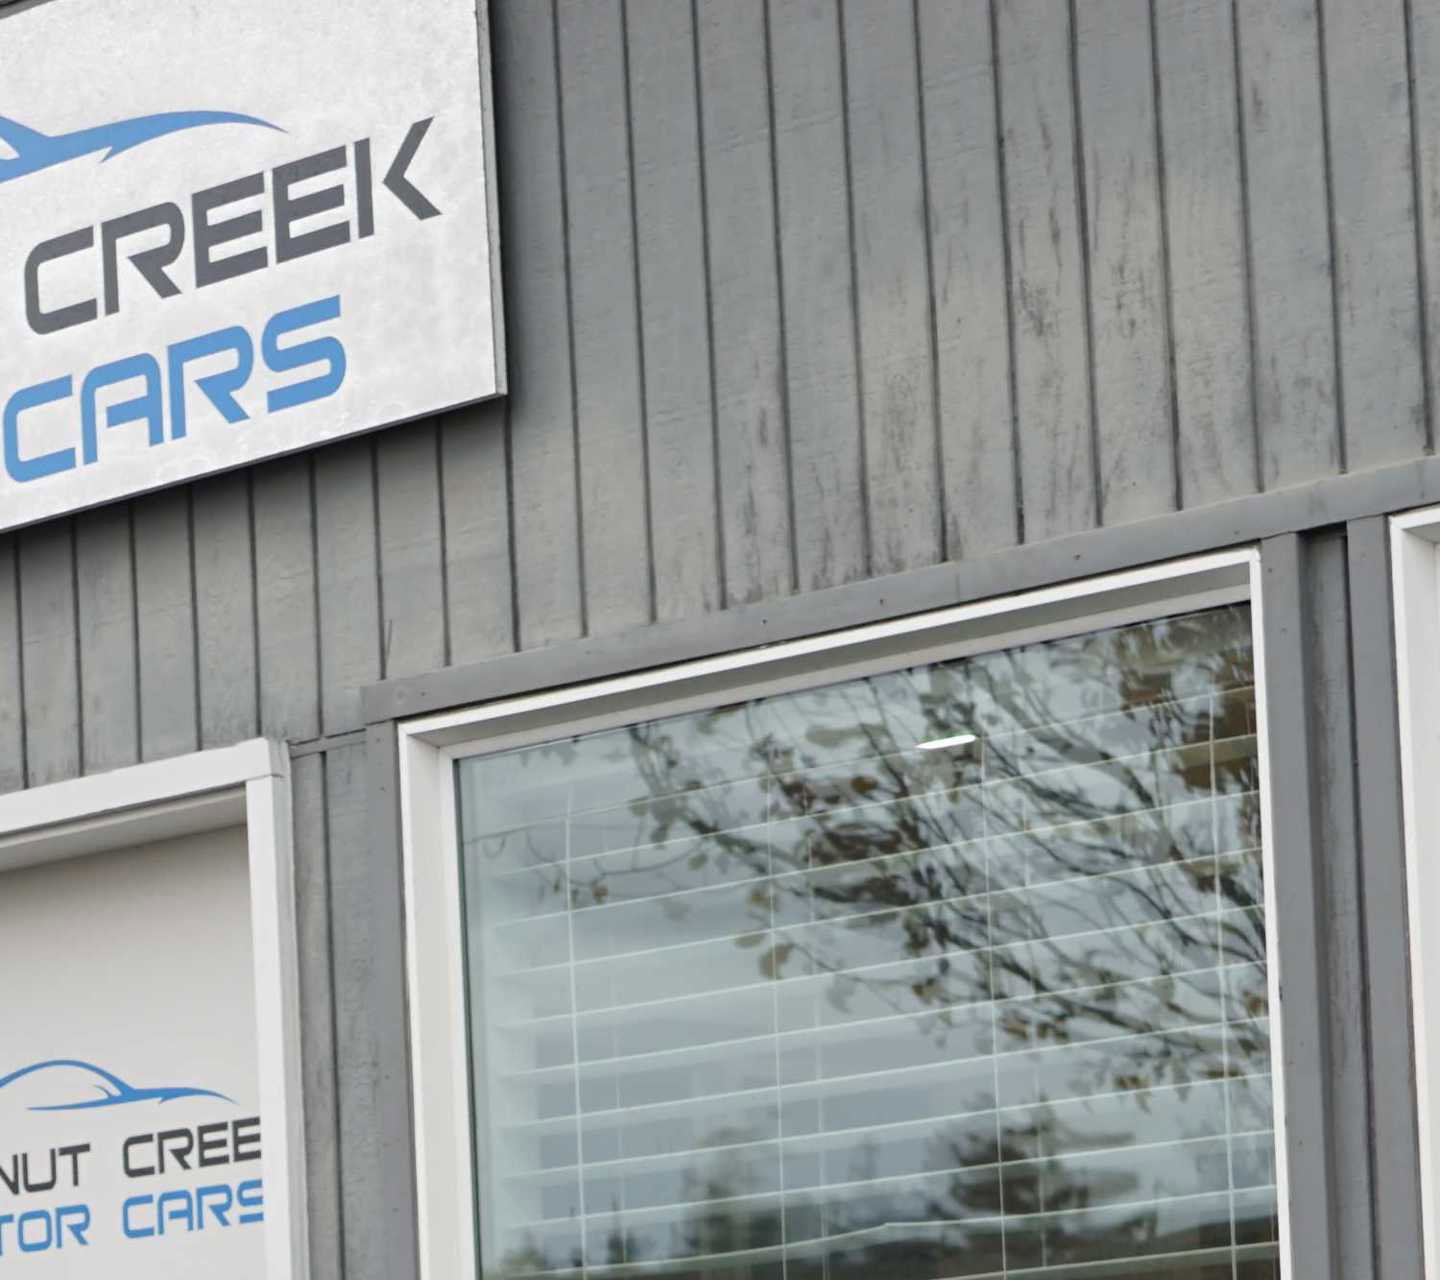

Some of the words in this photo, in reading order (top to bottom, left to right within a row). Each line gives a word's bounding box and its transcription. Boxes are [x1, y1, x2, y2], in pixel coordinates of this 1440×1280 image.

[23, 116, 441, 336] CREEK
[2, 294, 347, 485] CARS
[122, 1116, 262, 1178] CREE
[122, 1179, 264, 1239] CARS
